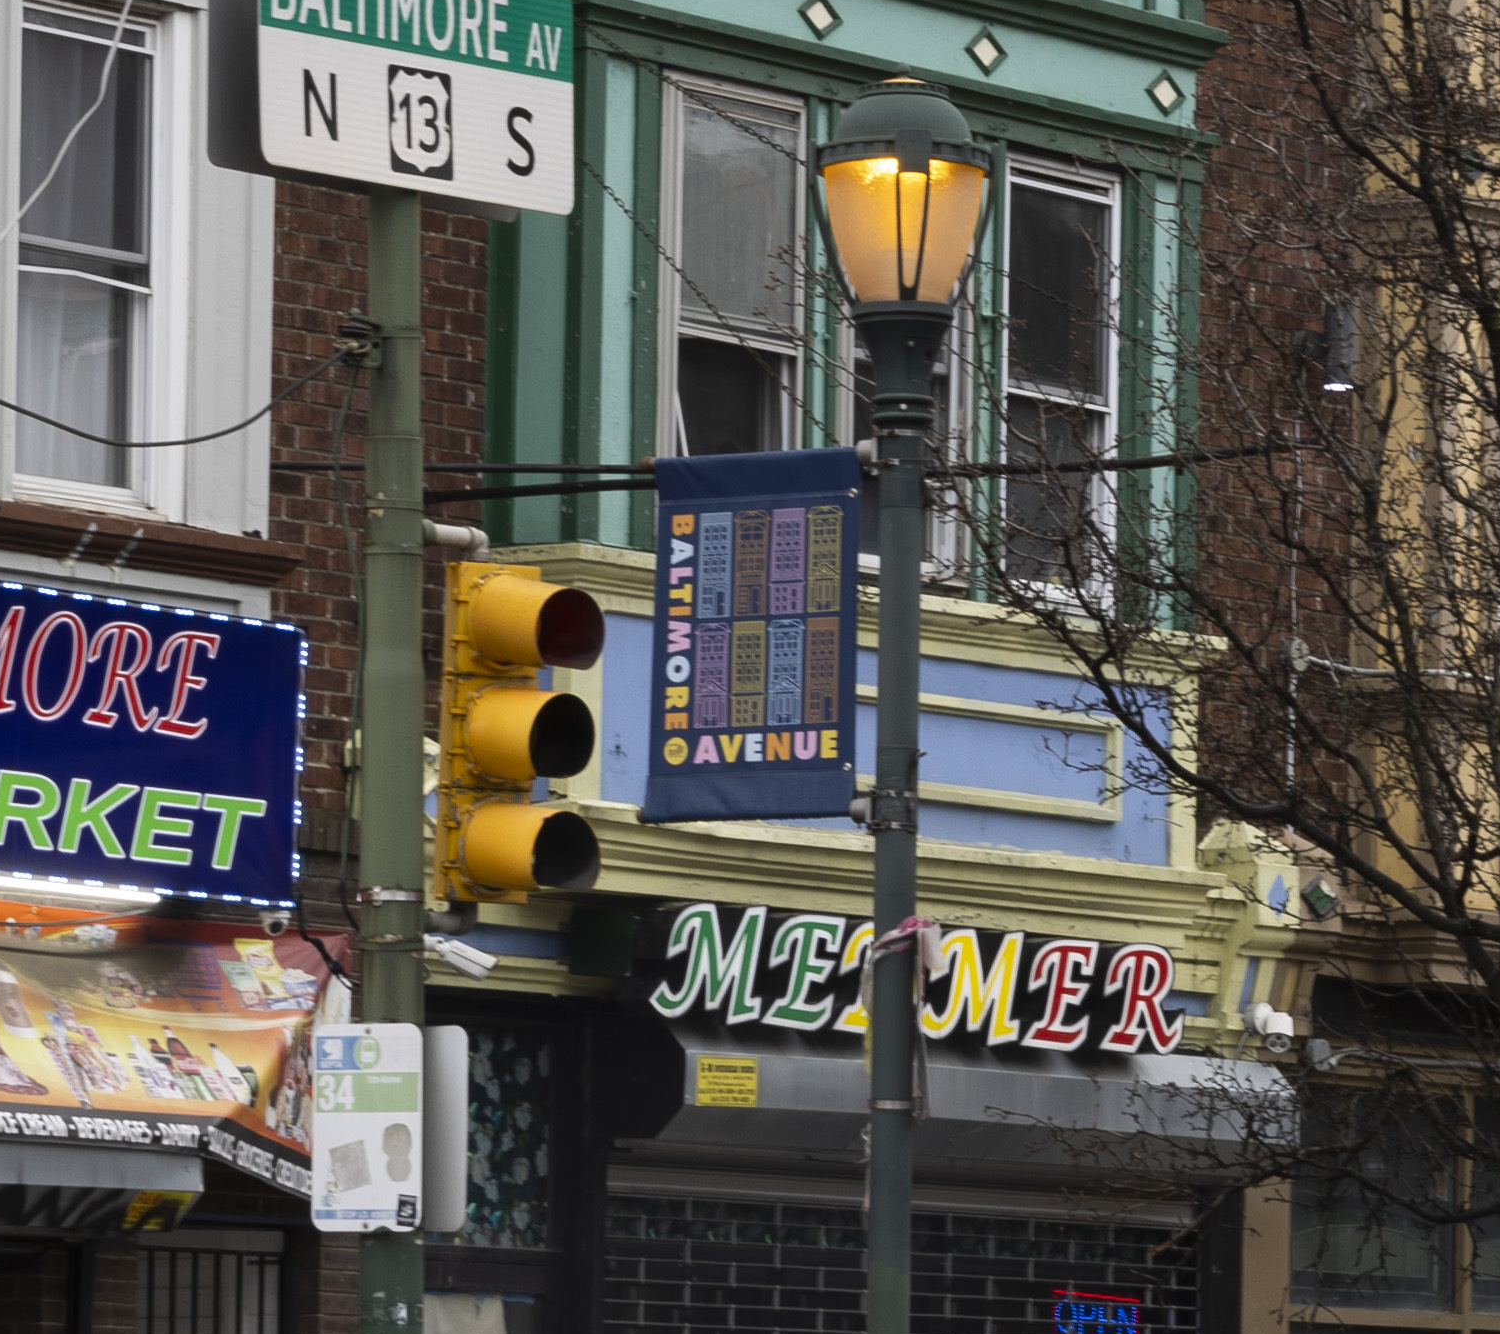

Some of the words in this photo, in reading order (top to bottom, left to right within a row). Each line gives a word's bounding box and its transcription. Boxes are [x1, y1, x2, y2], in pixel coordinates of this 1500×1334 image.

[525, 22, 563, 73] AV
[303, 68, 339, 142] N
[399, 94, 441, 154] 13
[505, 107, 536, 177] S
[662, 514, 696, 731] BALTIMORE
[693, 729, 839, 765] AVENUE
[318, 1074, 356, 1111] 34
[16, 1114, 69, 1138] CREAM
[71, 1116, 153, 1145] BEVERAGES
